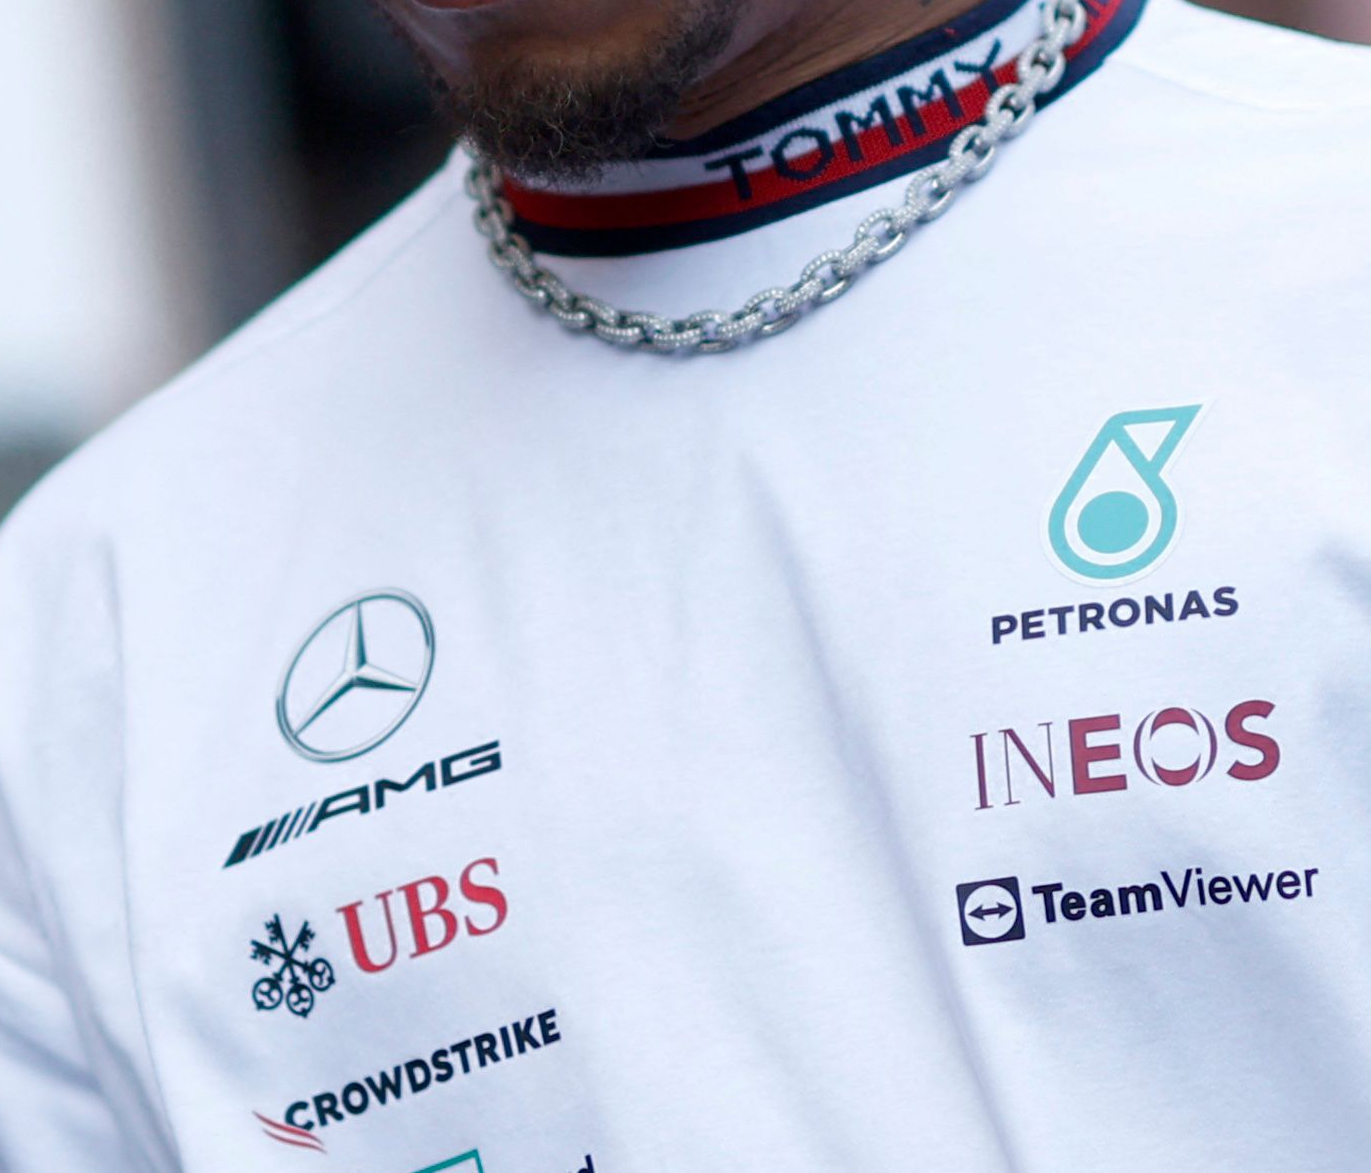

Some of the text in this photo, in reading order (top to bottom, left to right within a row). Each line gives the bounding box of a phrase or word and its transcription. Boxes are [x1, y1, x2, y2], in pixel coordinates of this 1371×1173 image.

[704, 38, 1002, 200] TOMMY
[992, 586, 1239, 644] PETRONAS
[306, 740, 503, 832] AMG
[970, 699, 1281, 811] INEOS
[335, 857, 509, 974] UBS
[1032, 867, 1319, 923] TeamViewer
[284, 1009, 561, 1130] CROWDSTRIKE
